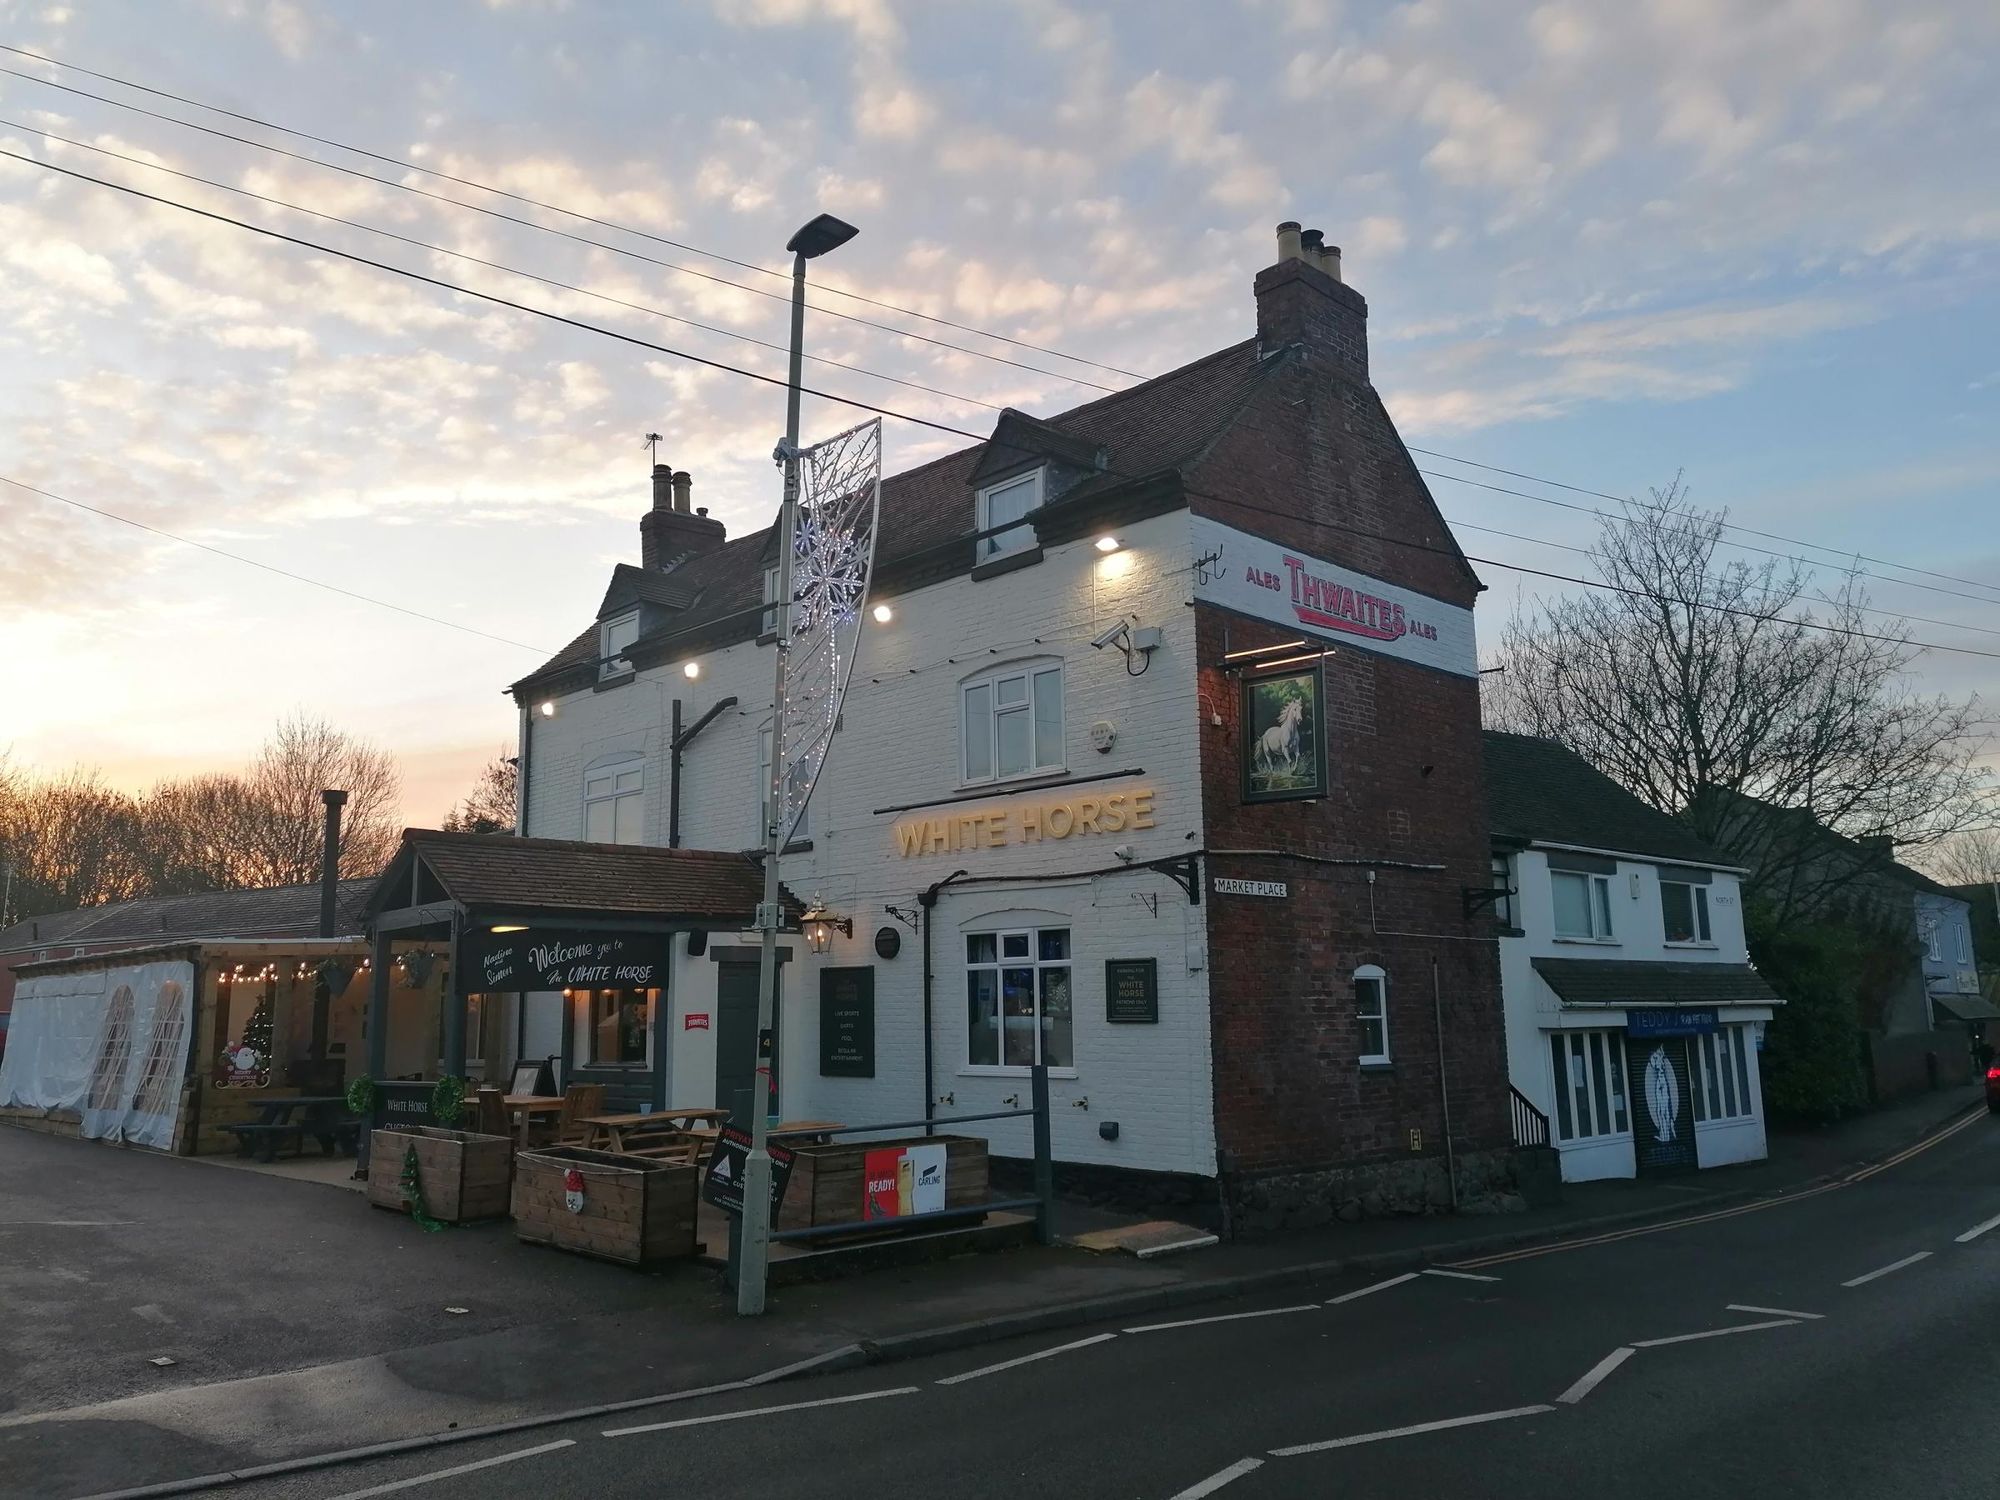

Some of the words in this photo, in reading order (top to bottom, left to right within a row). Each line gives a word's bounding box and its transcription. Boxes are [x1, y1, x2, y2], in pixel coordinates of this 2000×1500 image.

[1245, 566, 1281, 592] ALES
[1282, 553, 1407, 637] THWAITES
[1409, 619, 1438, 642] ALES
[894, 811, 1007, 857] WHITE
[1021, 790, 1155, 843] HORSE
[1217, 879, 1255, 894] MARKET
[1257, 882, 1285, 897] PLACE
[528, 941, 593, 973] Welcome
[597, 943, 611, 960] you
[613, 939, 624, 951] to
[567, 964, 612, 984] WHITE
[614, 964, 654, 984] HORSE
[1118, 980, 1145, 989] WHITE
[1118, 989, 1145, 998] HORSE
[868, 1178, 895, 1194] READY!
[918, 1175, 941, 1187] CARLING
